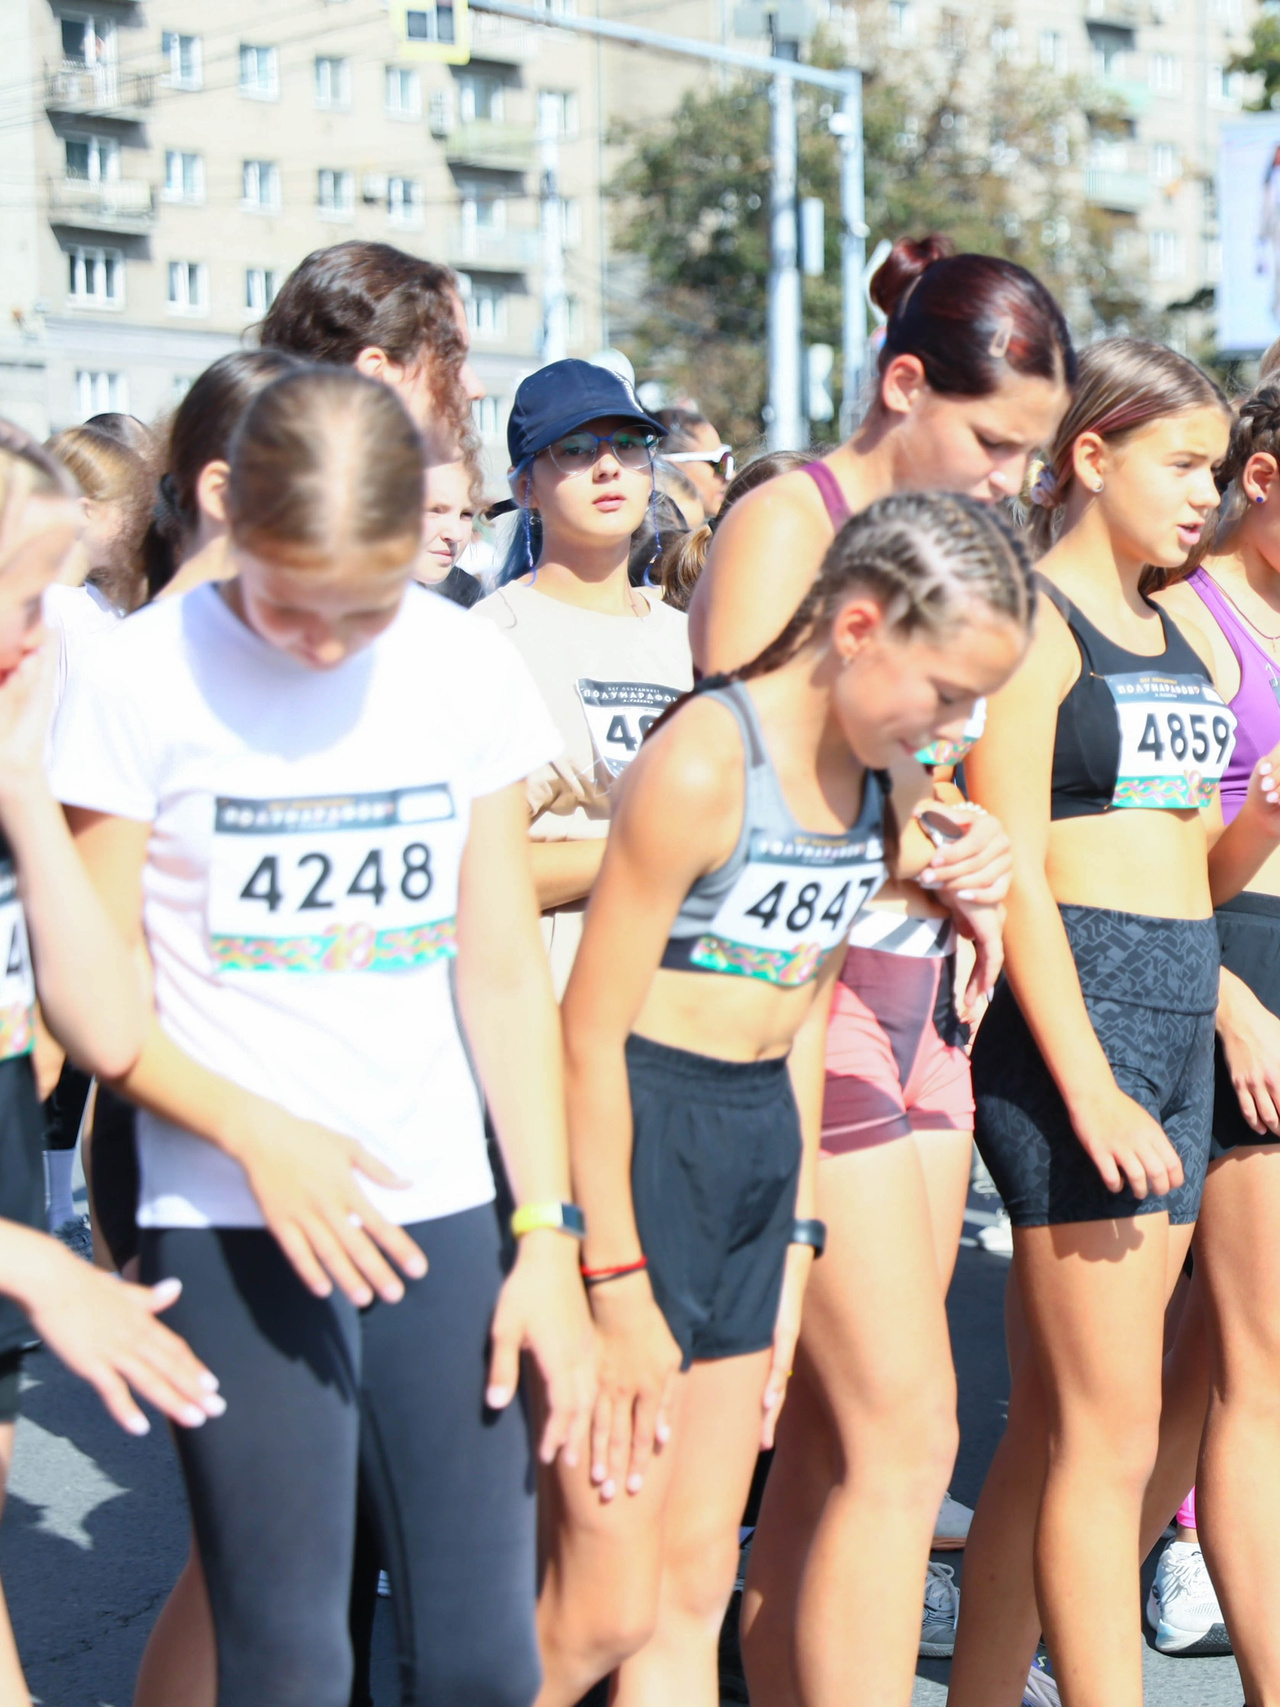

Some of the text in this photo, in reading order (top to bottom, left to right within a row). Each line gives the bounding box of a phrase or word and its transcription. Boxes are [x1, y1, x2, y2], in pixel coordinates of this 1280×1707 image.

[1137, 712, 1230, 765] 4859
[240, 842, 434, 913] 4248
[743, 876, 878, 933] 4847
